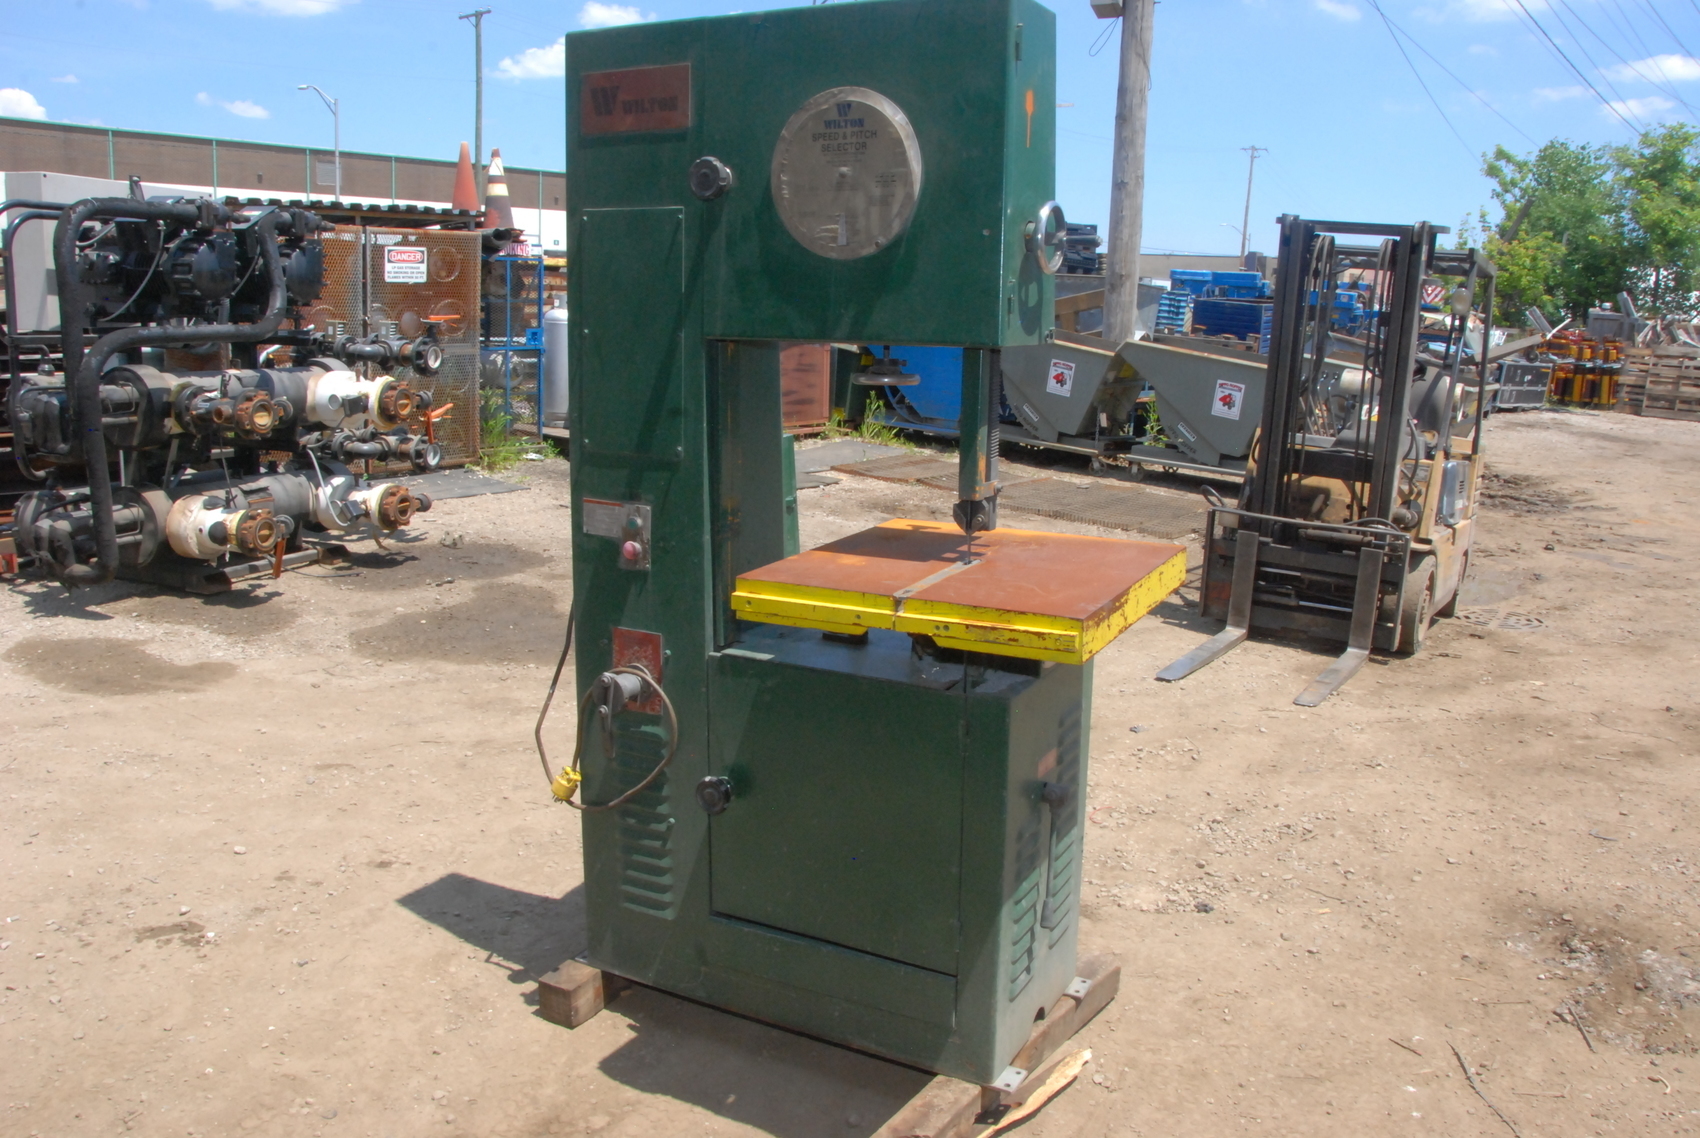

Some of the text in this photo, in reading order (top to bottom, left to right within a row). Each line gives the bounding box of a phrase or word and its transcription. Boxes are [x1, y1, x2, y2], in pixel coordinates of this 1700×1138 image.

[622, 95, 679, 115] WILTON
[823, 118, 865, 130] WILTON
[812, 129, 878, 142] SPEED & PITCH
[821, 141, 867, 152] SELECTOR
[391, 252, 421, 261] DANGER
